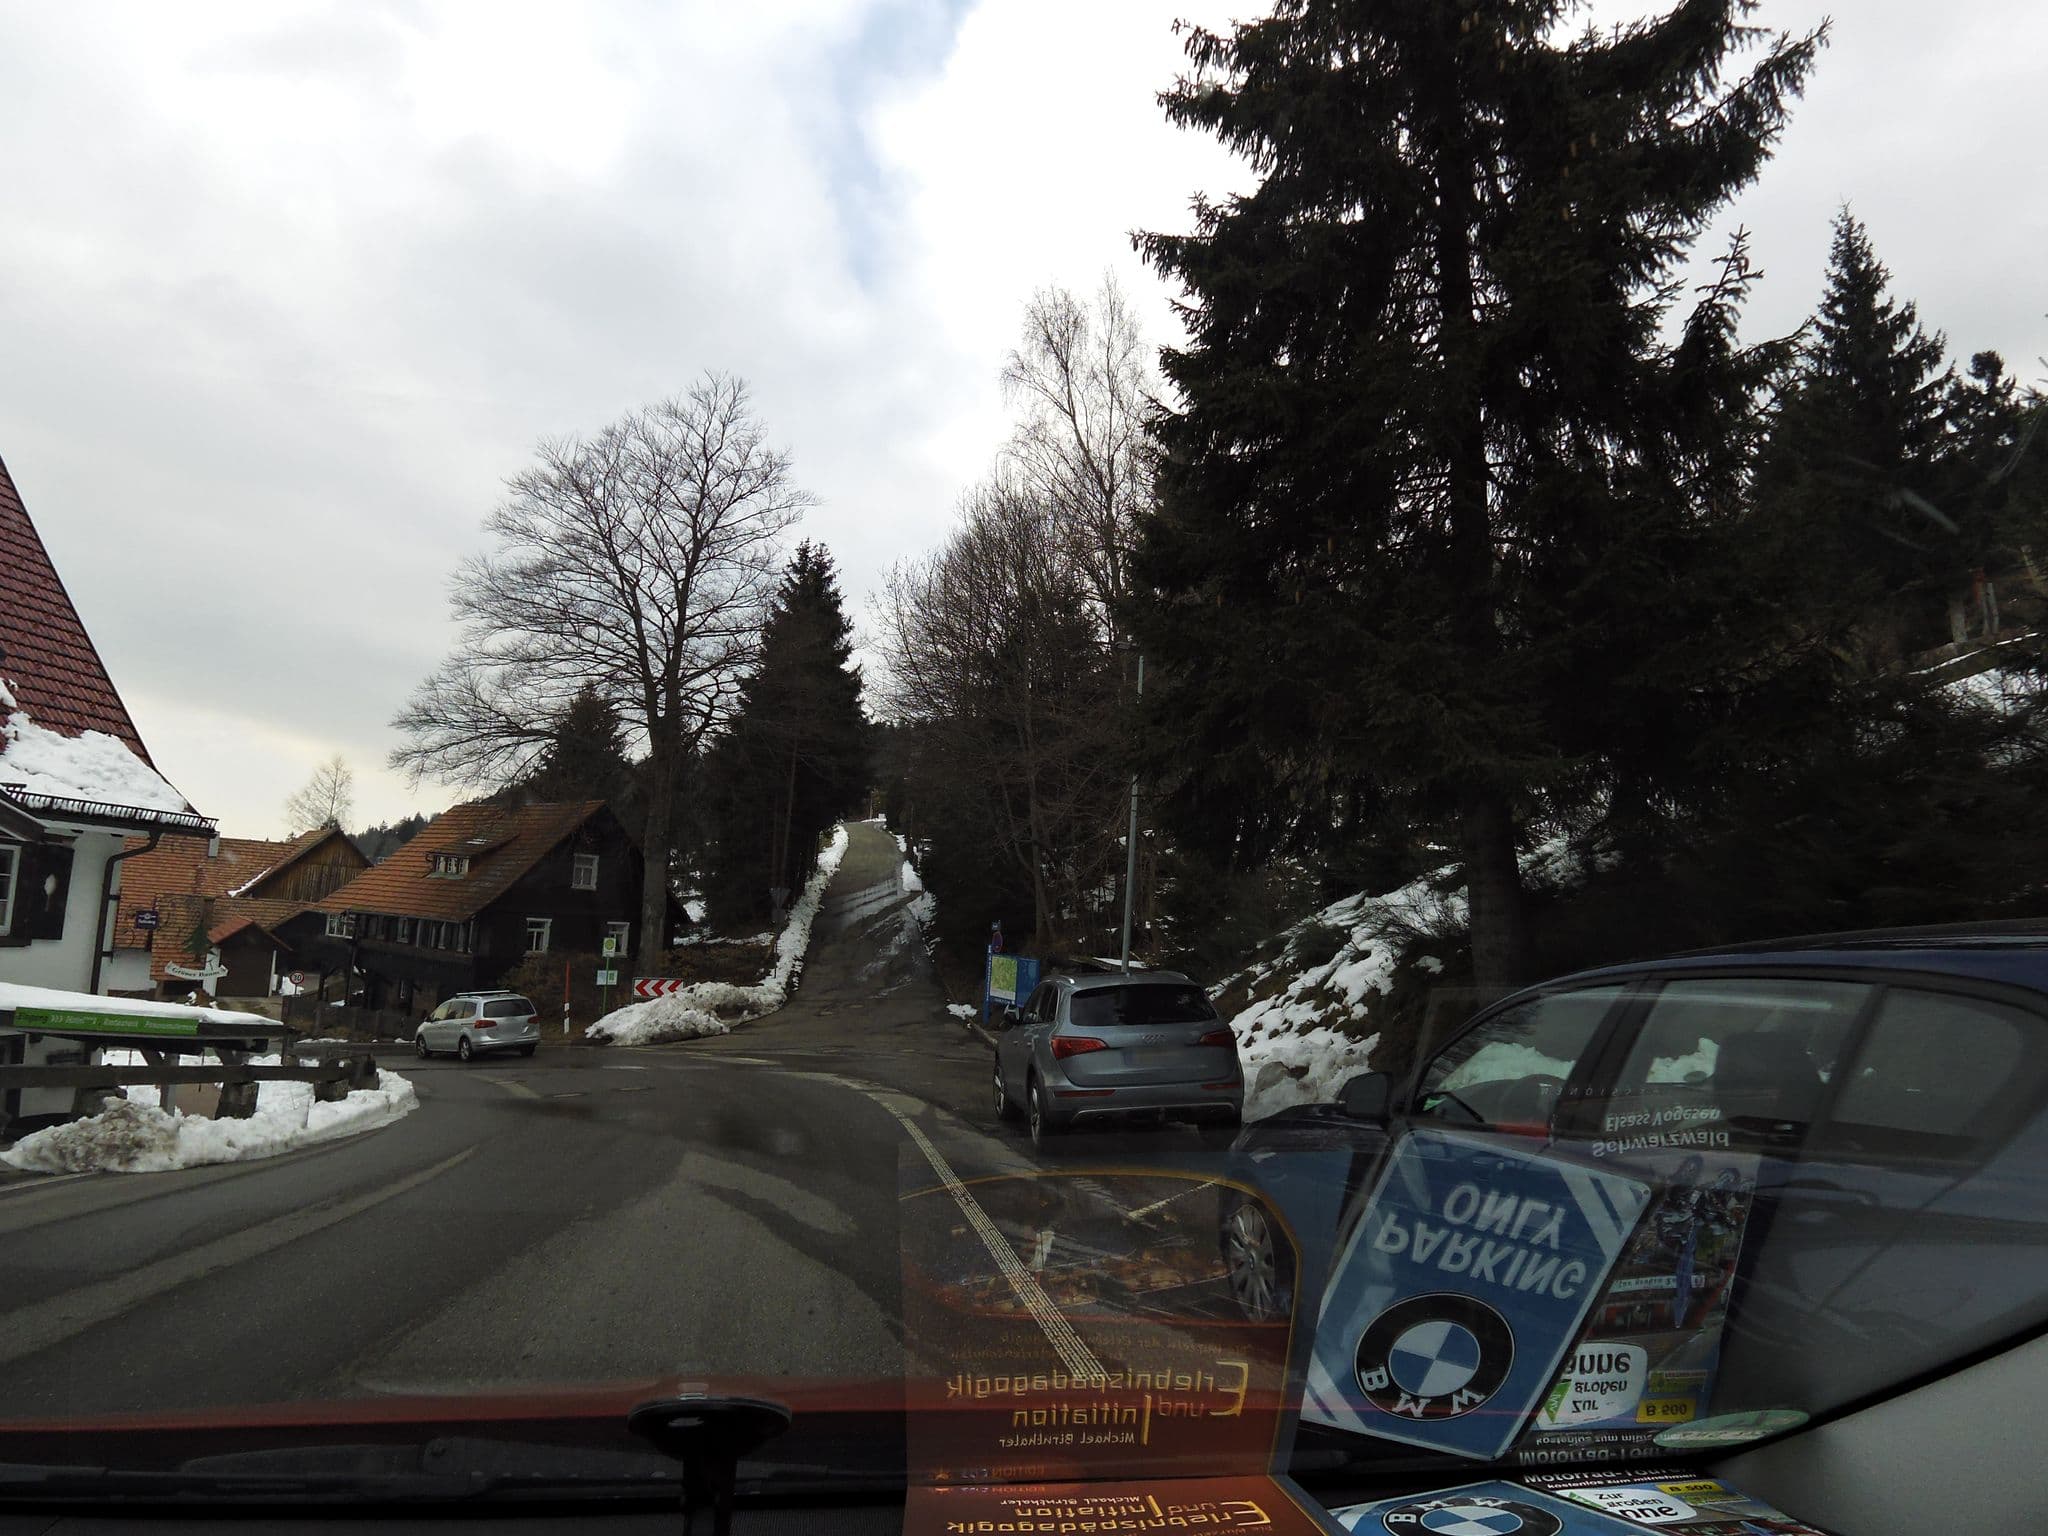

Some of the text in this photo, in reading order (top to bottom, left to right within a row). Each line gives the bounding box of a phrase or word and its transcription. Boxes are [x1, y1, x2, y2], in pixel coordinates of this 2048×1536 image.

[1547, 1473, 1697, 1489] kostenlos zum mitnehmen
[1686, 1484, 1712, 1492] 500
[1083, 1495, 1140, 1506] Michael
[1598, 1492, 1625, 1501] Zur
[1606, 1498, 1665, 1509] großen
[1014, 1494, 1217, 1519] und Initiation
[1388, 1496, 1513, 1524] BMW
[1619, 1505, 1679, 1519] nne
[947, 1500, 1271, 1534] Erlebnispädagogik
